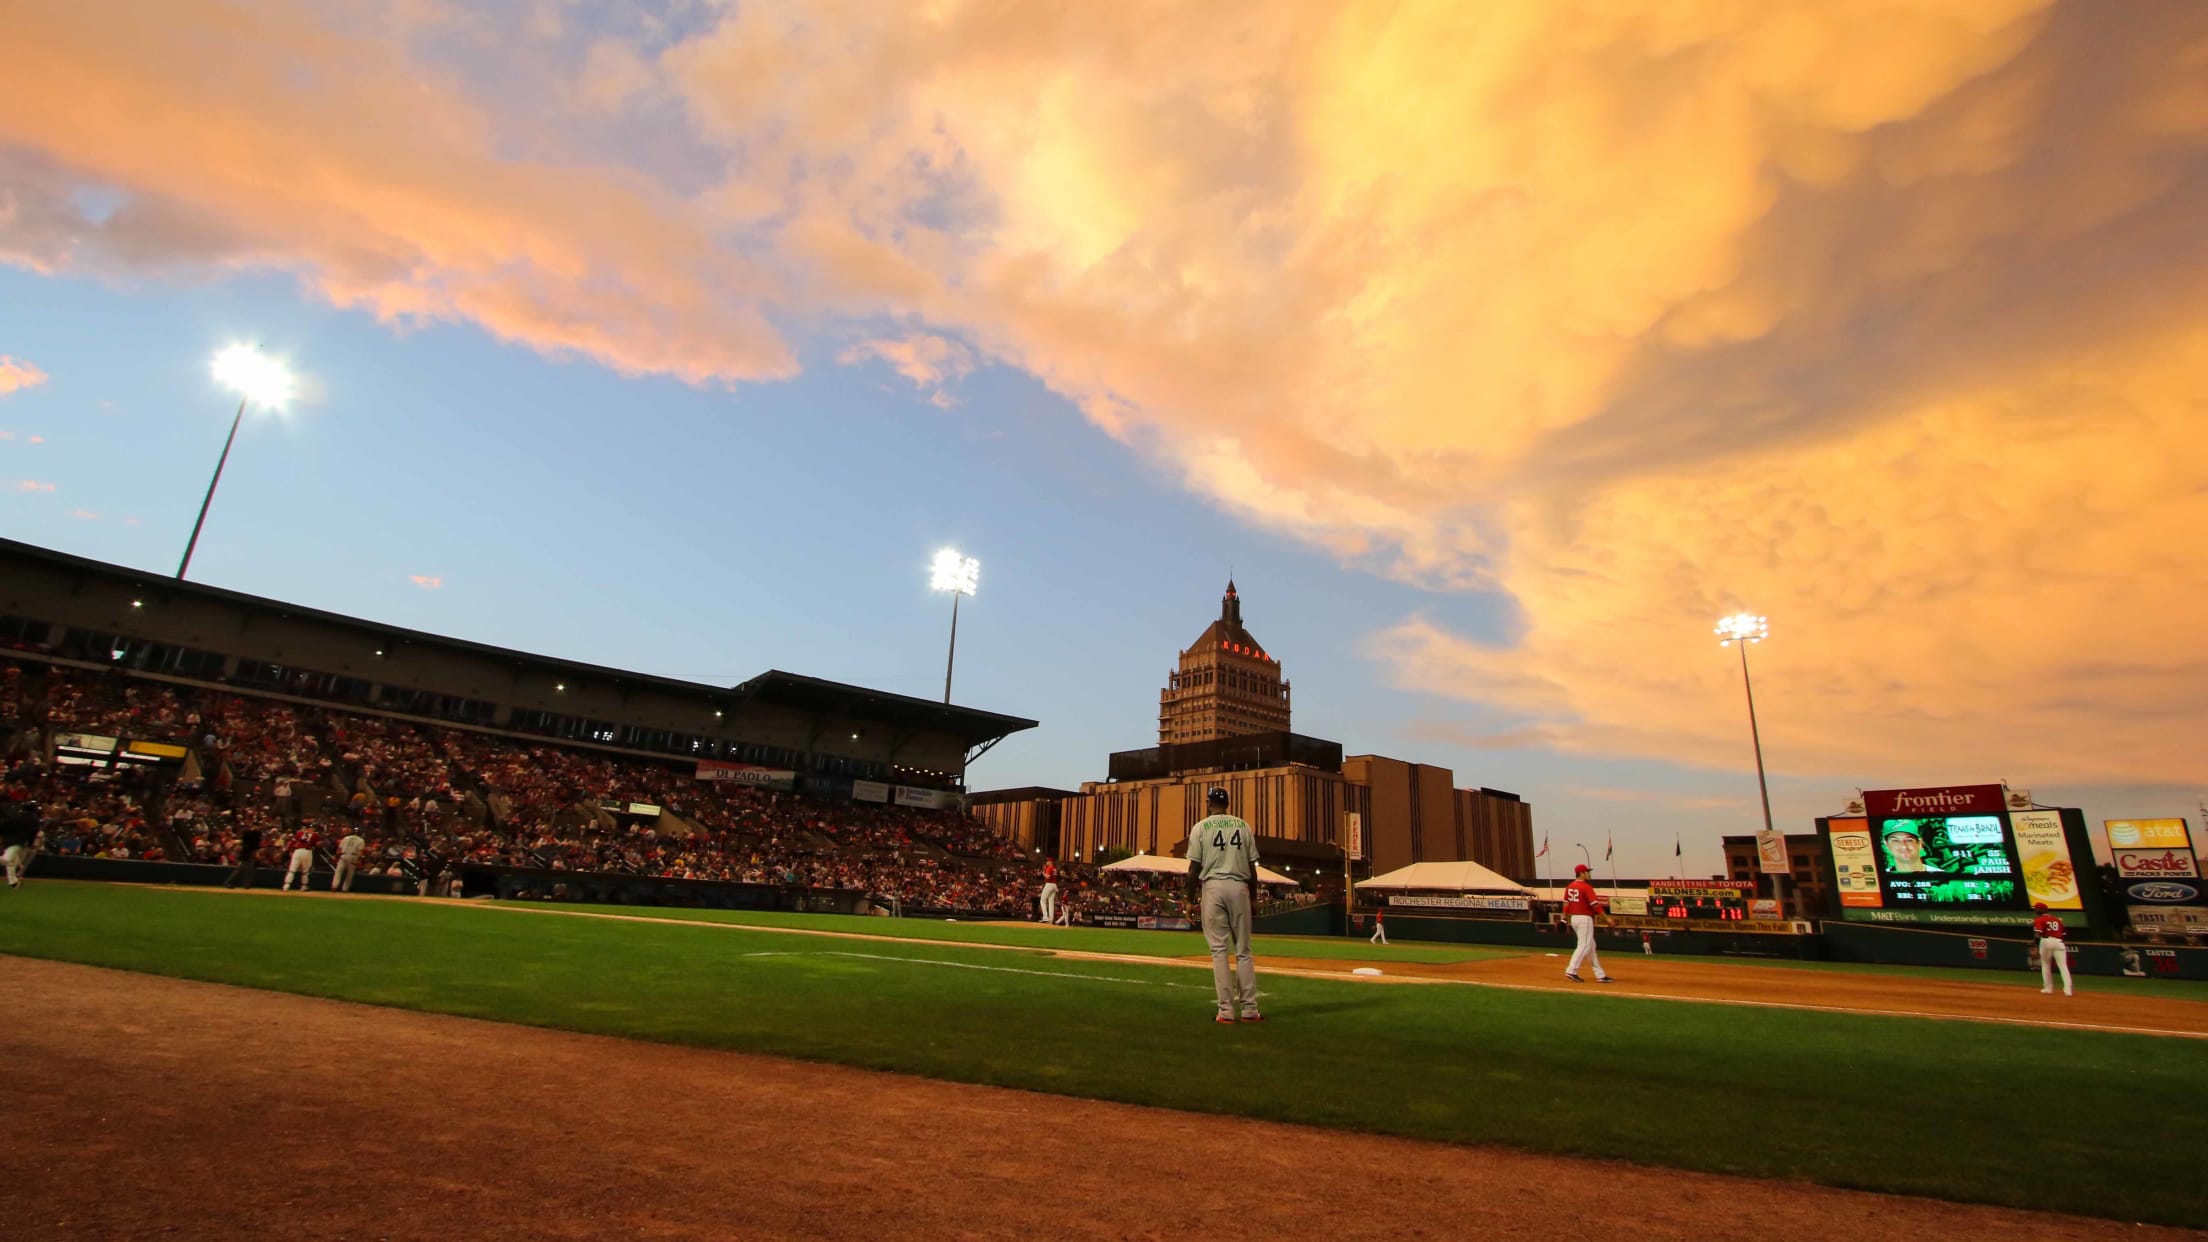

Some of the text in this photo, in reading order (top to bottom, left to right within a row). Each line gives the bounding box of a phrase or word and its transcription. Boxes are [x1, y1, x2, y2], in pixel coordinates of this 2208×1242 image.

[1223, 640, 1270, 661] KODAK
[716, 768, 771, 783] DI PAOLO
[1892, 790, 1976, 812] frontier
[1203, 819, 1246, 830] WASHINGTON
[2028, 821, 2058, 829] meals
[2143, 824, 2183, 838] at&t
[1213, 829, 1242, 851] 44
[2120, 850, 2188, 871] Castle
[1974, 866, 2012, 875] JANISH
[1567, 888, 1580, 902] 52
[1654, 887, 1734, 897] BALDNESS.com
[2142, 885, 2184, 899] Ford
[1393, 897, 1523, 909] ROCHESTER REGIONAL HEALTH
[1930, 914, 1988, 924] Understanding
[2135, 913, 2166, 923] TASTE
[2046, 921, 2059, 931] 38
